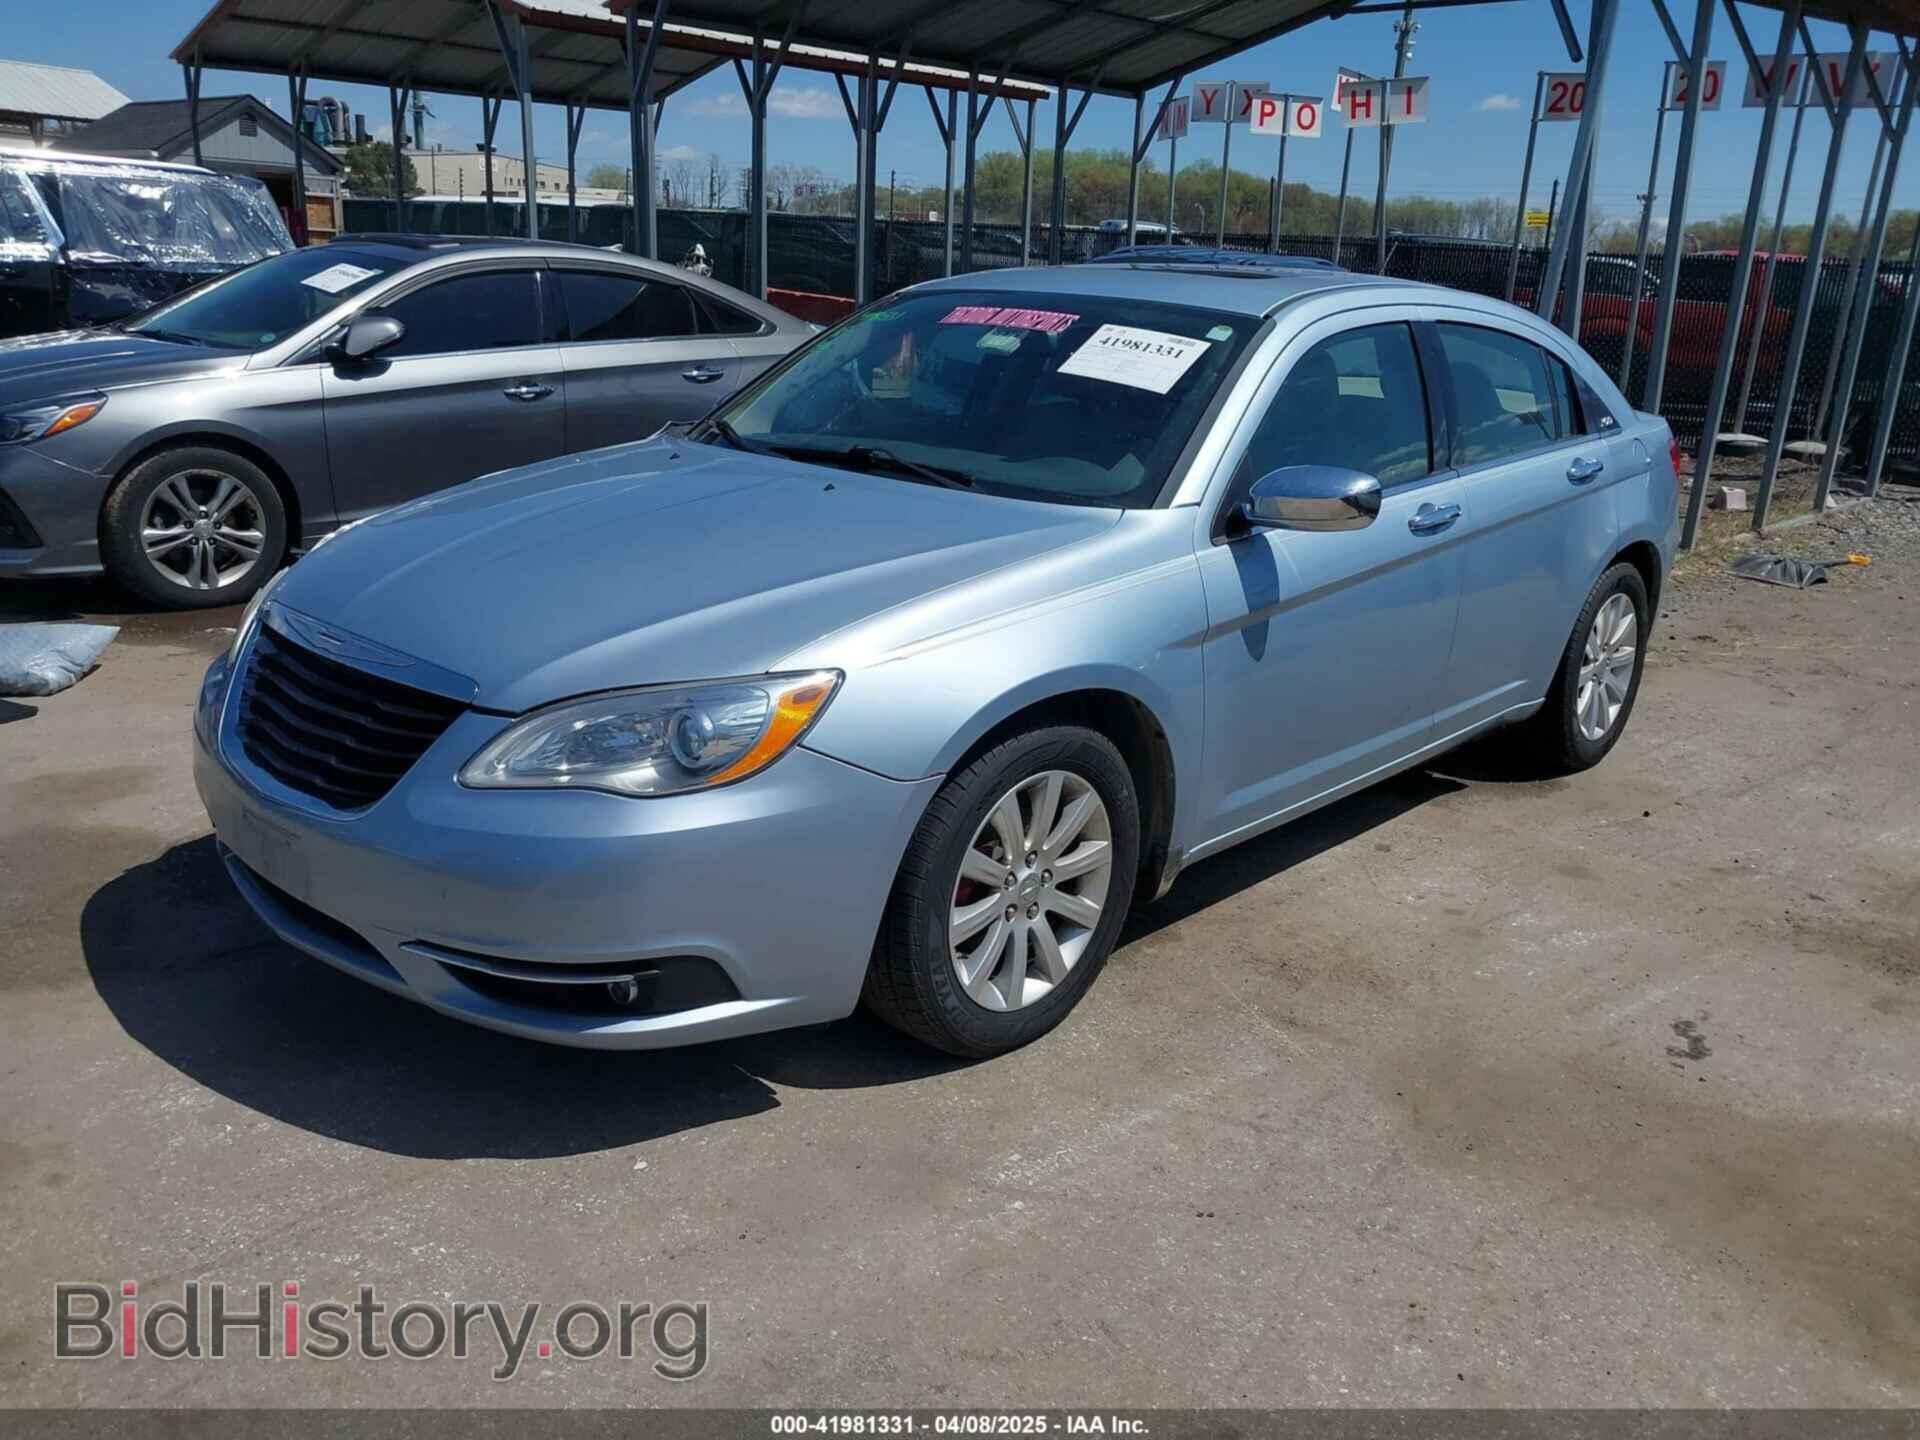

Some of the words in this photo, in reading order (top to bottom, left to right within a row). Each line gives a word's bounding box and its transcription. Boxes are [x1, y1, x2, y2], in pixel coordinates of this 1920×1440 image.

[1200, 89, 1218, 115] Y
[1351, 89, 1371, 119] H
[1548, 81, 1585, 113] 20
[1259, 100, 1276, 127] P
[1099, 335, 1184, 359] 41981331
